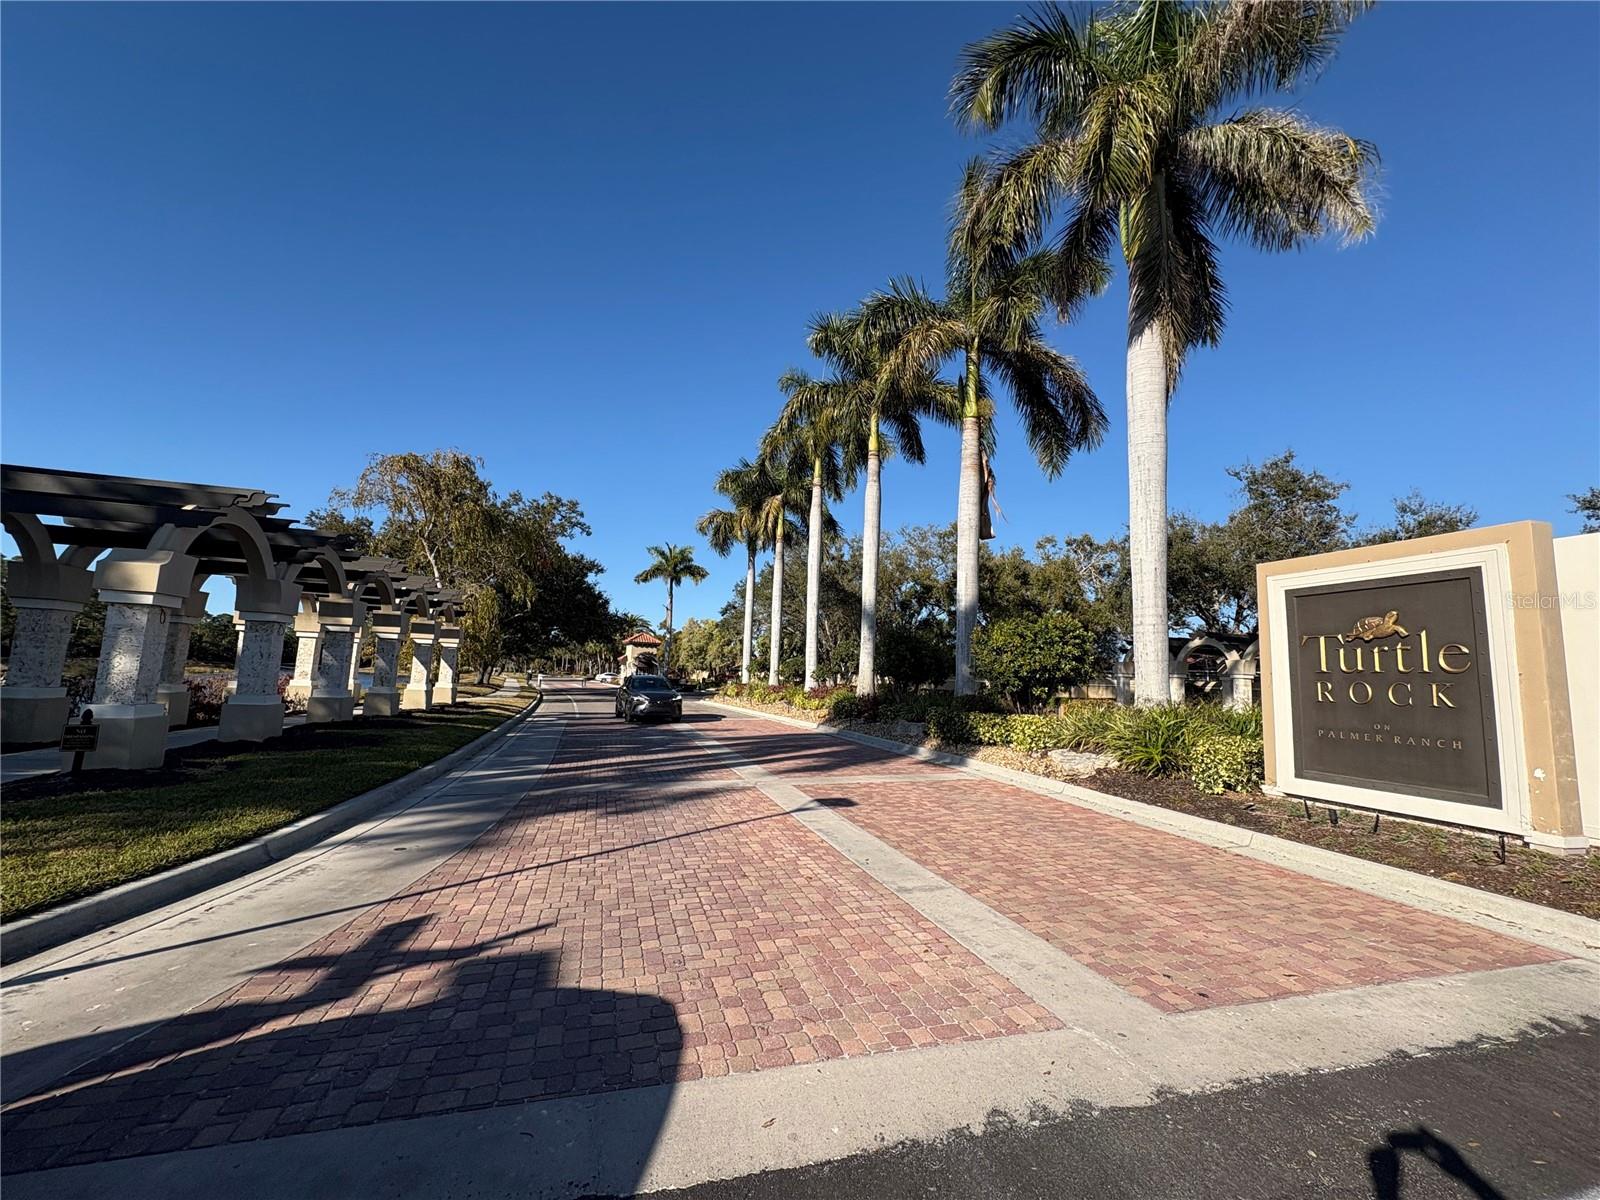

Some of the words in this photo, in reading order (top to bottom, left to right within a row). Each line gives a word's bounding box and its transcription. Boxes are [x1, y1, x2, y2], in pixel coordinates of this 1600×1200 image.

[1301, 629, 1472, 674] Turtle
[1316, 680, 1456, 708] ROCK
[1373, 722, 1391, 731] ON
[1318, 729, 1384, 743] PALMER
[1394, 736, 1463, 750] RANCH
